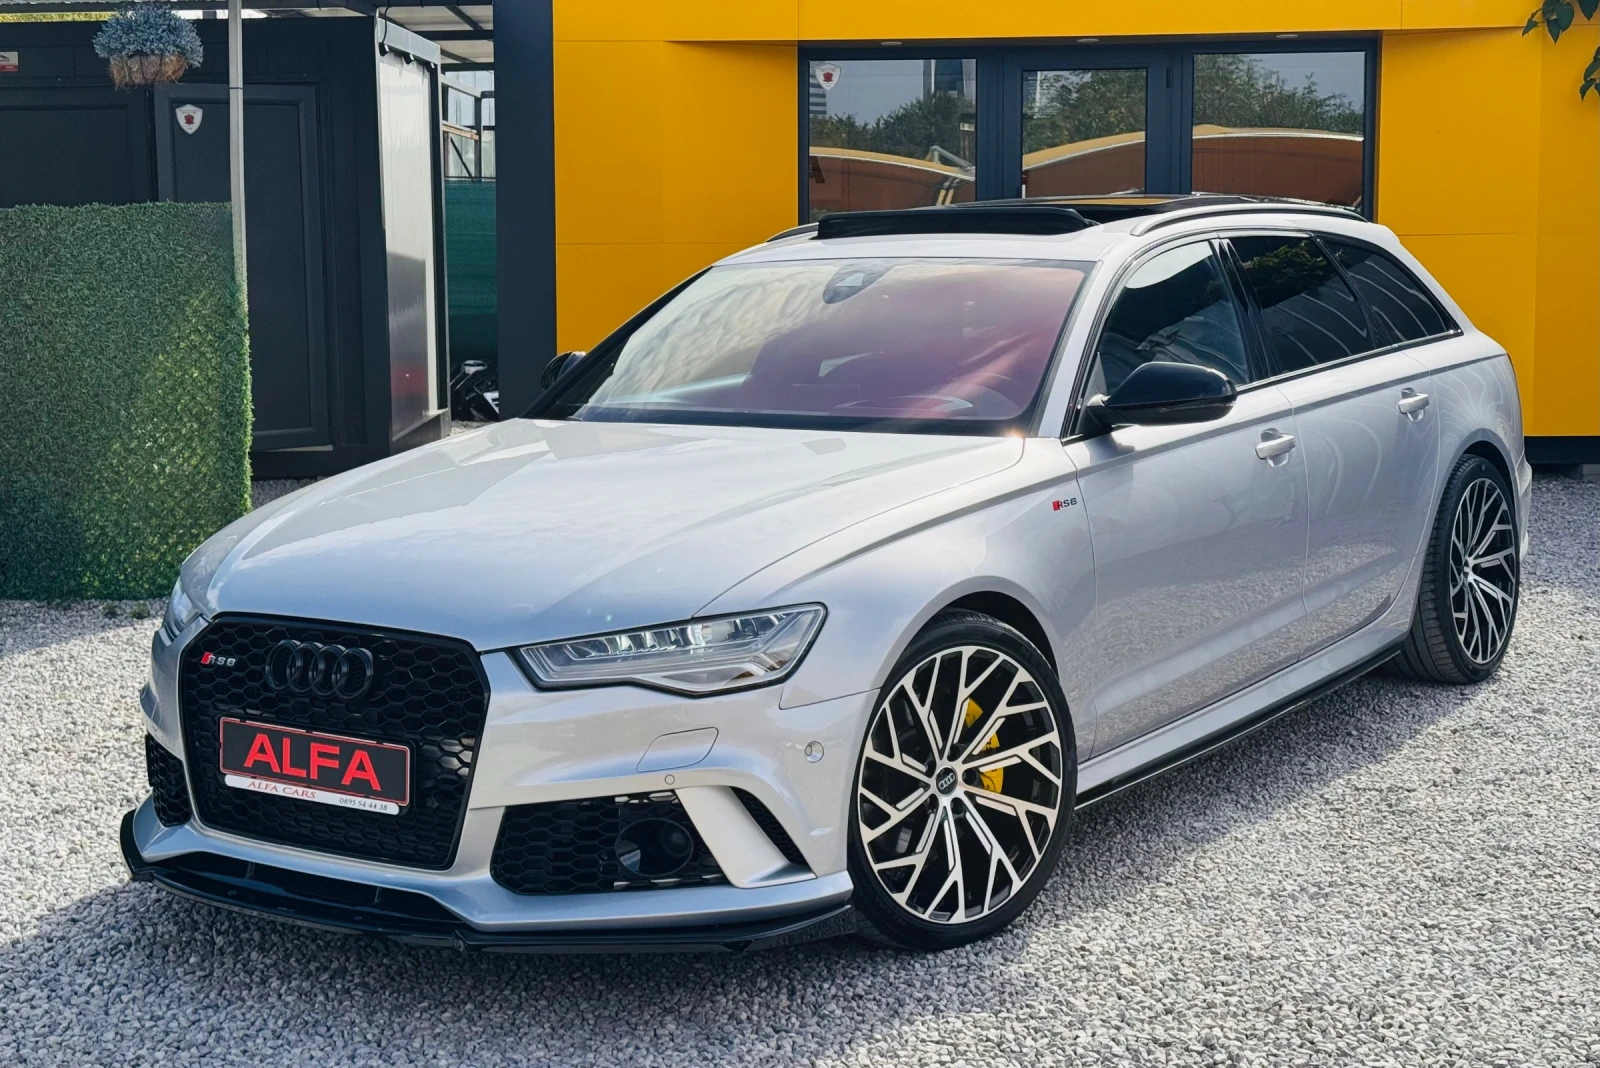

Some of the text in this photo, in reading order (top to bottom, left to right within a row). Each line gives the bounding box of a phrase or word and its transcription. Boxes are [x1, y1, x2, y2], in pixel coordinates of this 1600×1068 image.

[1053, 497, 1078, 511] RS6
[202, 652, 236, 666] RS6
[243, 733, 382, 791] ALFA
[247, 780, 317, 799] ALFA CARS
[339, 797, 388, 811] 0895 54 44 38
